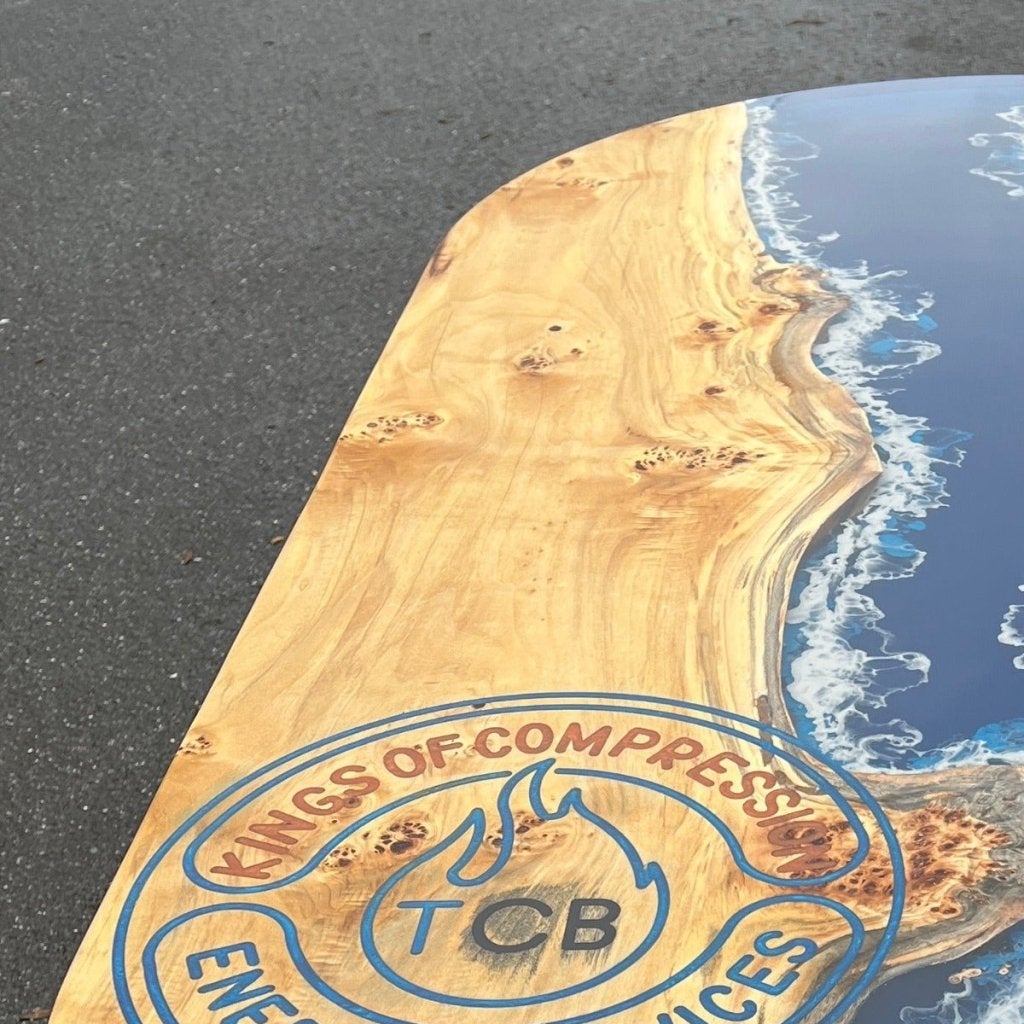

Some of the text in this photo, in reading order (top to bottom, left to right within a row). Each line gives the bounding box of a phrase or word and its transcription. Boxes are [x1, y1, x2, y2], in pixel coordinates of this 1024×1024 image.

[210, 722, 840, 880] KINGS OF COMPRESSION
[397, 898, 621, 956] TCB
